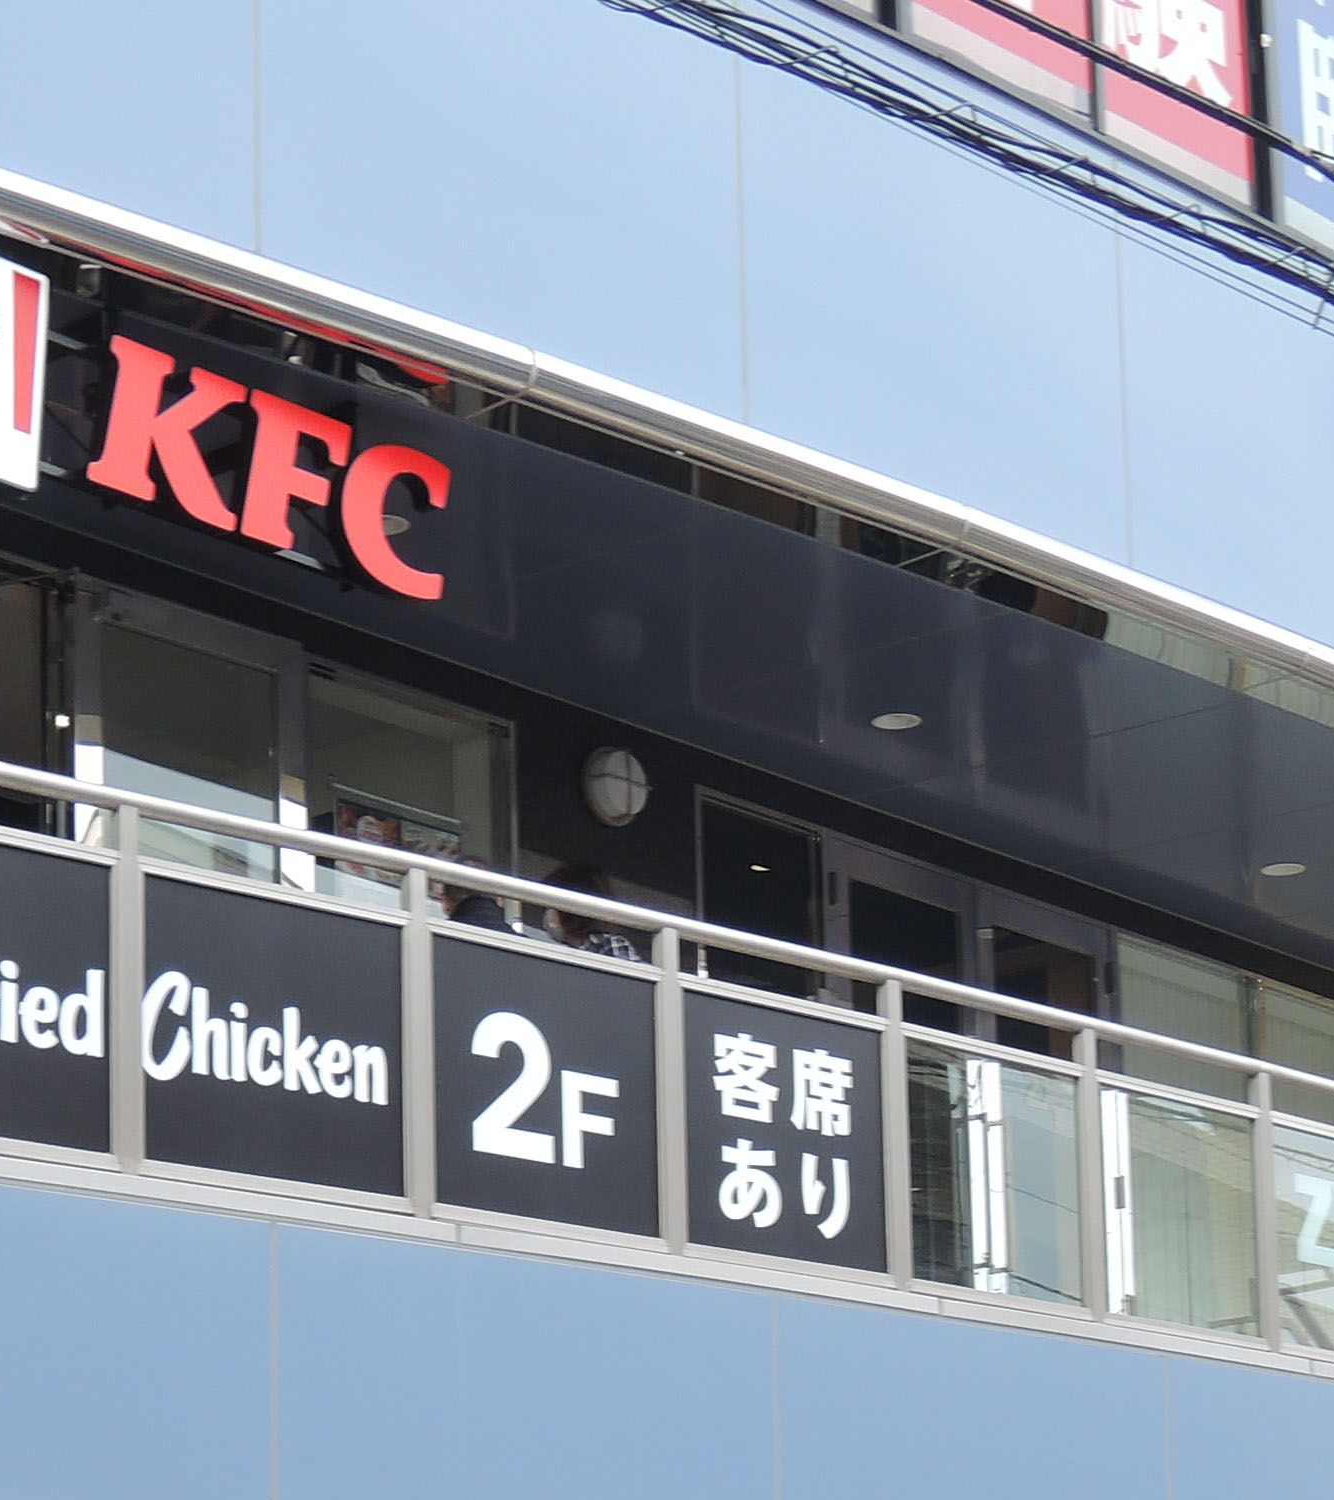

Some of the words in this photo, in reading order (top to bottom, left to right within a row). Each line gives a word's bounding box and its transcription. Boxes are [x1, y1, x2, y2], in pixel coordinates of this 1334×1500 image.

[86, 334, 451, 600] KFC
[140, 970, 390, 1107] Chicken
[469, 1010, 622, 1170] 2F
[712, 1030, 855, 1139] 客席
[717, 1136, 853, 1242] あり
